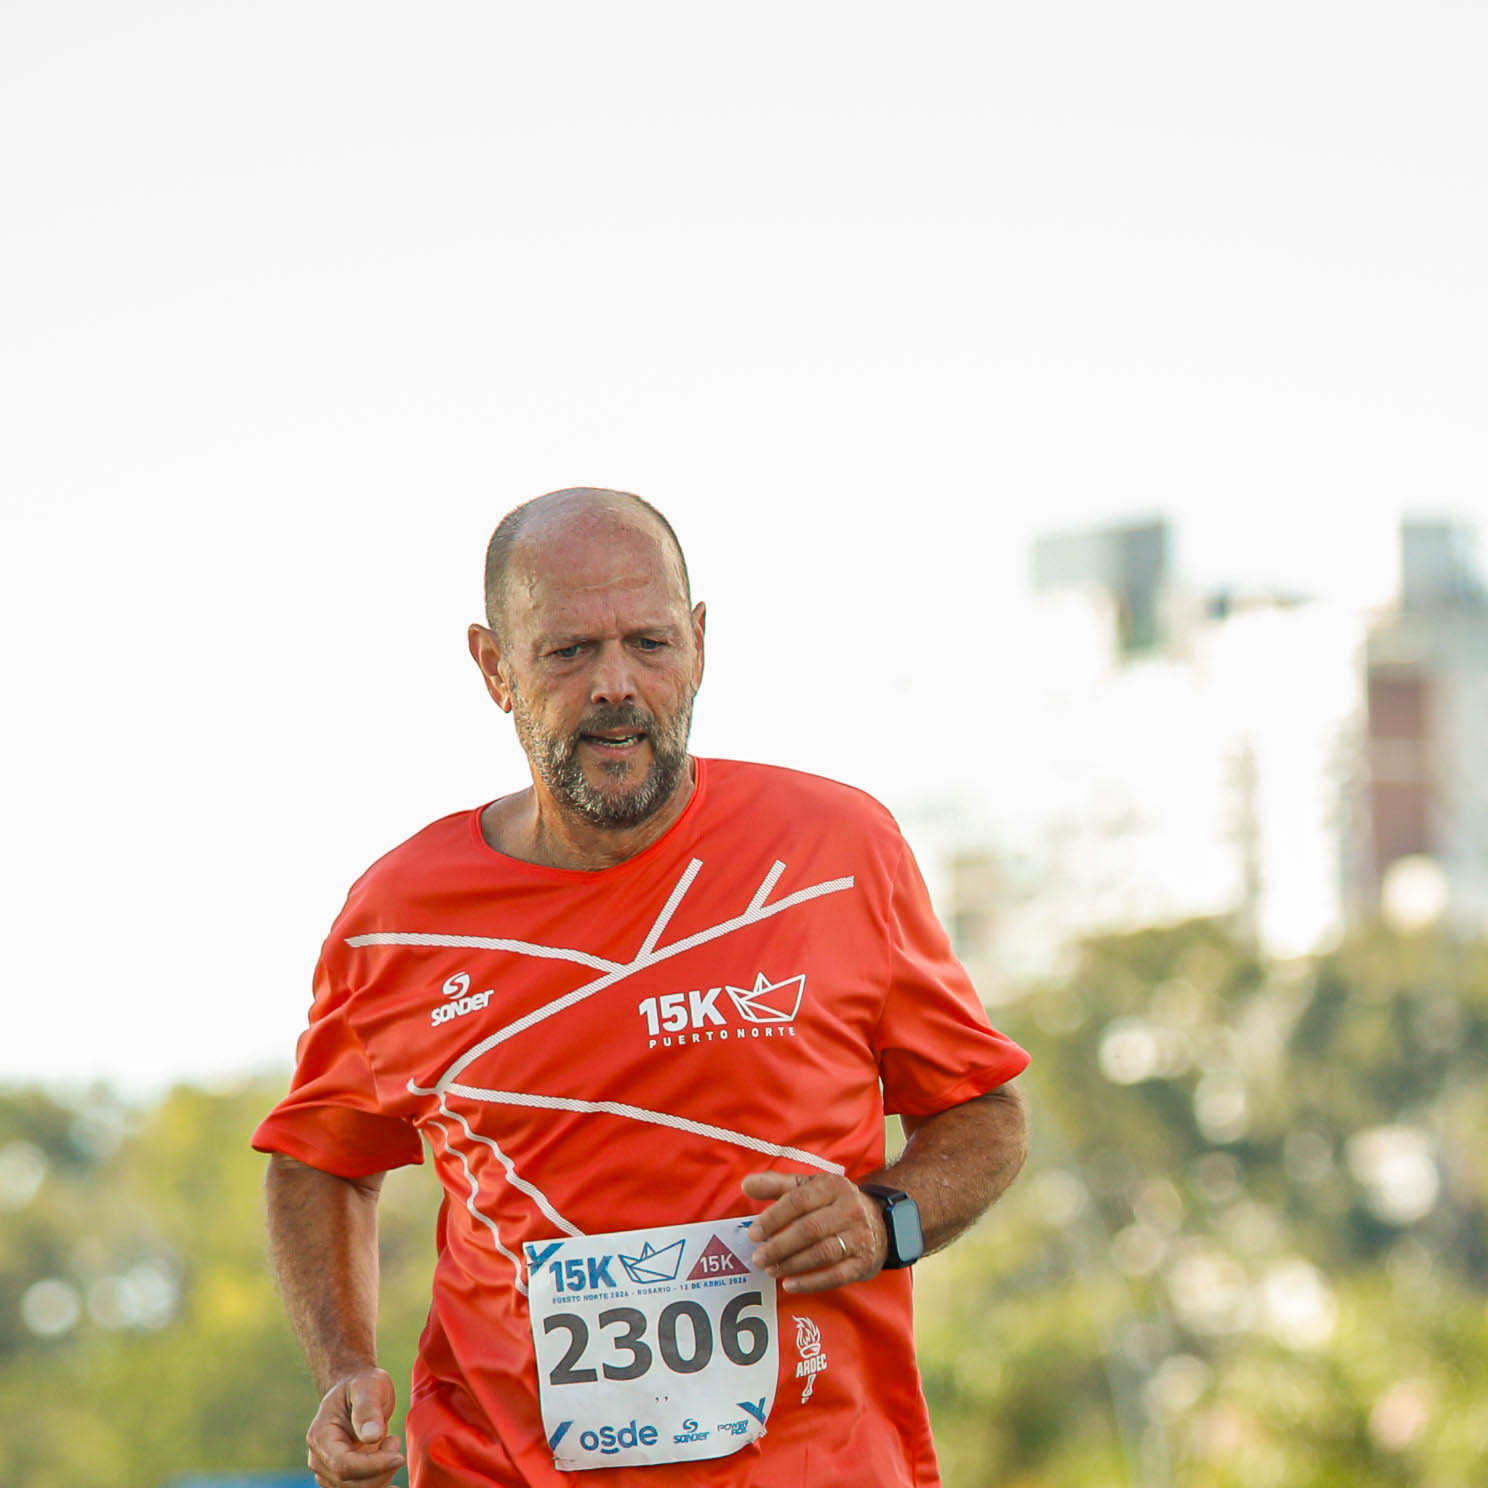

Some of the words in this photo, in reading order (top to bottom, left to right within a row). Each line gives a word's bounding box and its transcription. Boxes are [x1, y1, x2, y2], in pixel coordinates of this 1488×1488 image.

[638, 987, 727, 1036] 15K
[649, 1029, 729, 1049] PUERTO
[737, 1026, 796, 1040] NORTE
[549, 1255, 617, 1293] 15K
[699, 1253, 734, 1273] 15K
[583, 1293, 608, 1302] NORTE
[637, 1286, 671, 1296] ROSARIO
[704, 1279, 726, 1288] ABRIL
[543, 1291, 770, 1386] 2306
[796, 1353, 828, 1378] ARDEC
[580, 1419, 658, 1453] osde
